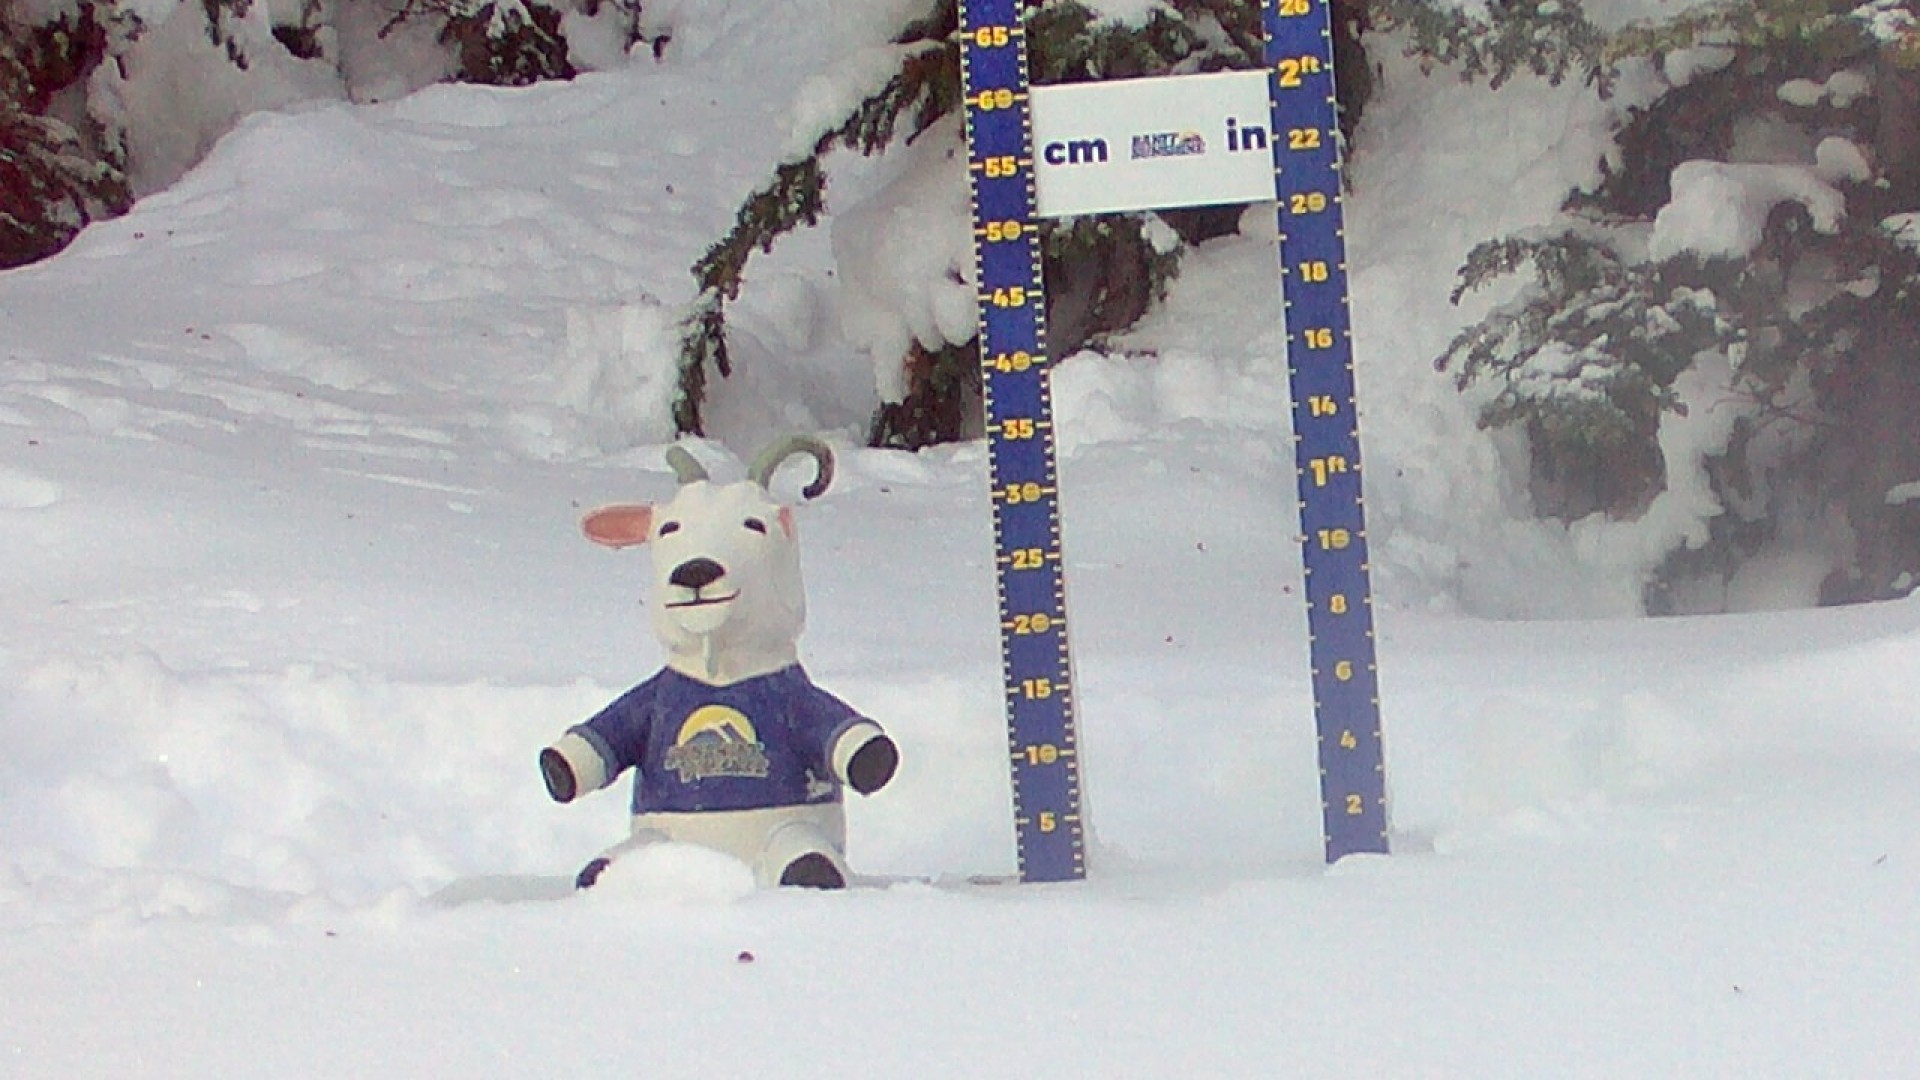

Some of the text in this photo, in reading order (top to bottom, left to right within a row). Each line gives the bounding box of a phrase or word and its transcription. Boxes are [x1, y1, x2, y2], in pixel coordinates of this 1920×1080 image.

[1279, 0, 1310, 16] 26
[975, 27, 1009, 47] 65
[978, 89, 1013, 110] 60
[1226, 117, 1267, 152] in
[1288, 128, 1321, 149] 22
[1044, 137, 1109, 166] cm
[984, 155, 1018, 177] 55
[1291, 193, 1326, 214] 20
[986, 221, 1021, 242] 50
[1299, 261, 1329, 283] 18
[992, 286, 1026, 308] 45
[1304, 328, 1333, 349] 16
[995, 351, 1033, 373] 40
[1308, 396, 1338, 416] 14
[1001, 418, 1035, 440] 35
[1005, 482, 1043, 505] 30
[1317, 528, 1350, 549] 10
[1011, 549, 1045, 570] 25
[1330, 594, 1347, 614] 8
[1013, 613, 1051, 635] 20
[1335, 661, 1353, 681] 6
[1022, 678, 1052, 699] 15
[1340, 730, 1357, 750] 4
[1026, 744, 1058, 764] 10
[1346, 794, 1363, 814] 2
[1039, 812, 1056, 832] 5
